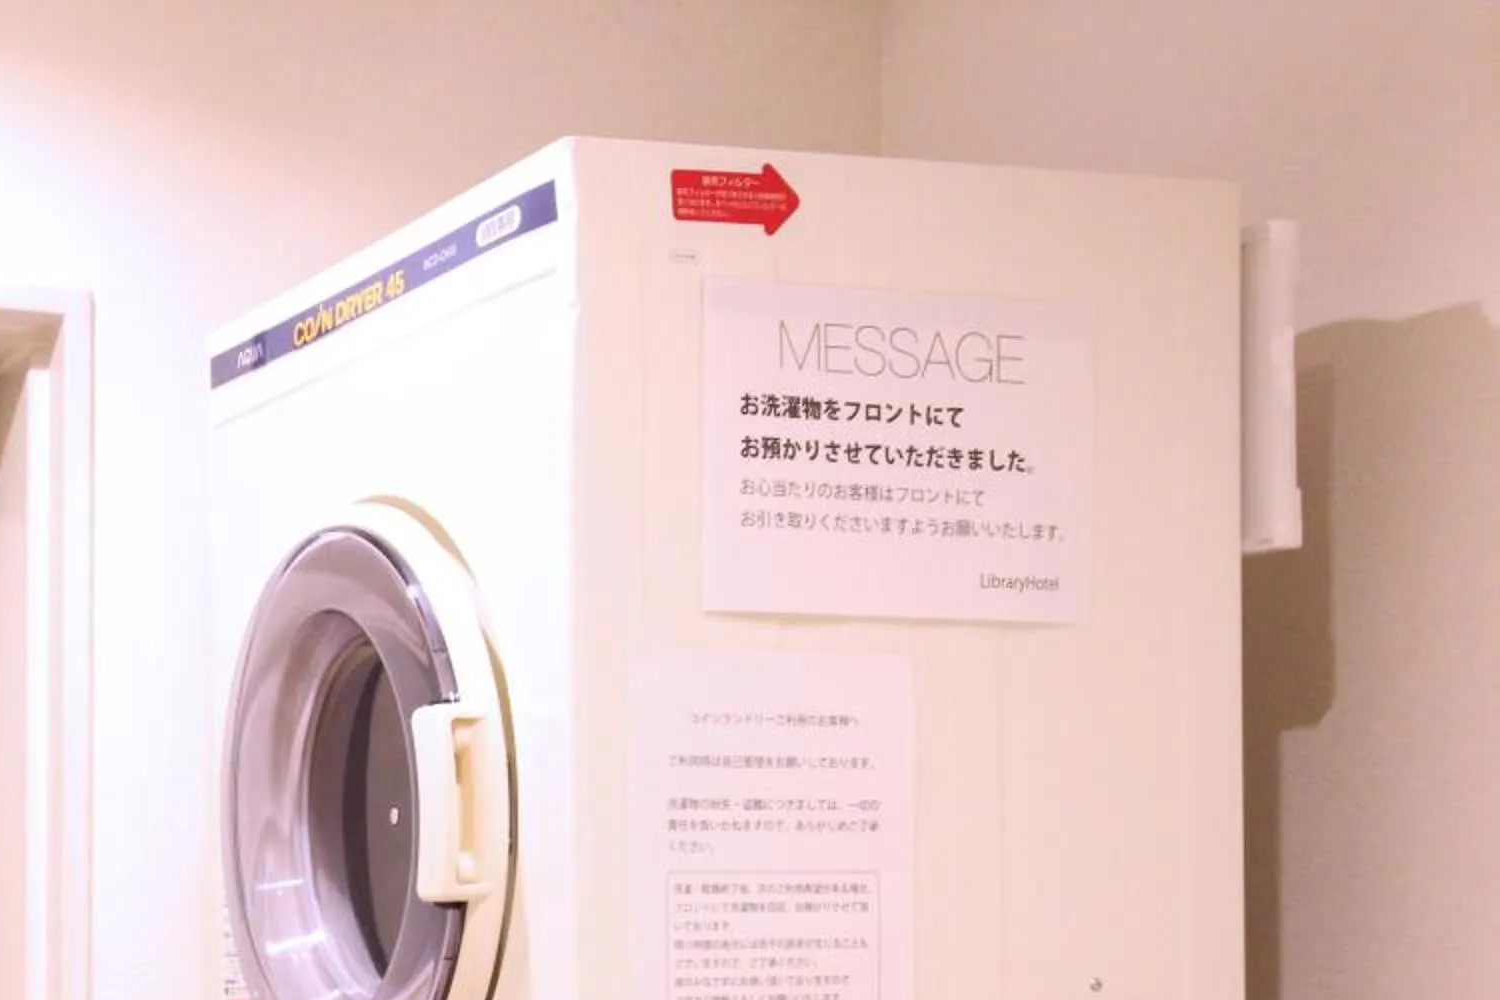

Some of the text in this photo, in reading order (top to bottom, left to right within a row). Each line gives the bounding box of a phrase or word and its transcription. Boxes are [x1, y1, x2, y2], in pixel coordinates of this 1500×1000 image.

[778, 319, 1026, 385] MESSAGE
[739, 393, 966, 428] お洗濯物をフロントにて
[739, 436, 1036, 475] お預かりさせていただきました。
[739, 478, 986, 508] お心当たりのお客様はフロントにて
[739, 510, 1066, 544] お引き取りくださいますようお願いいたします。
